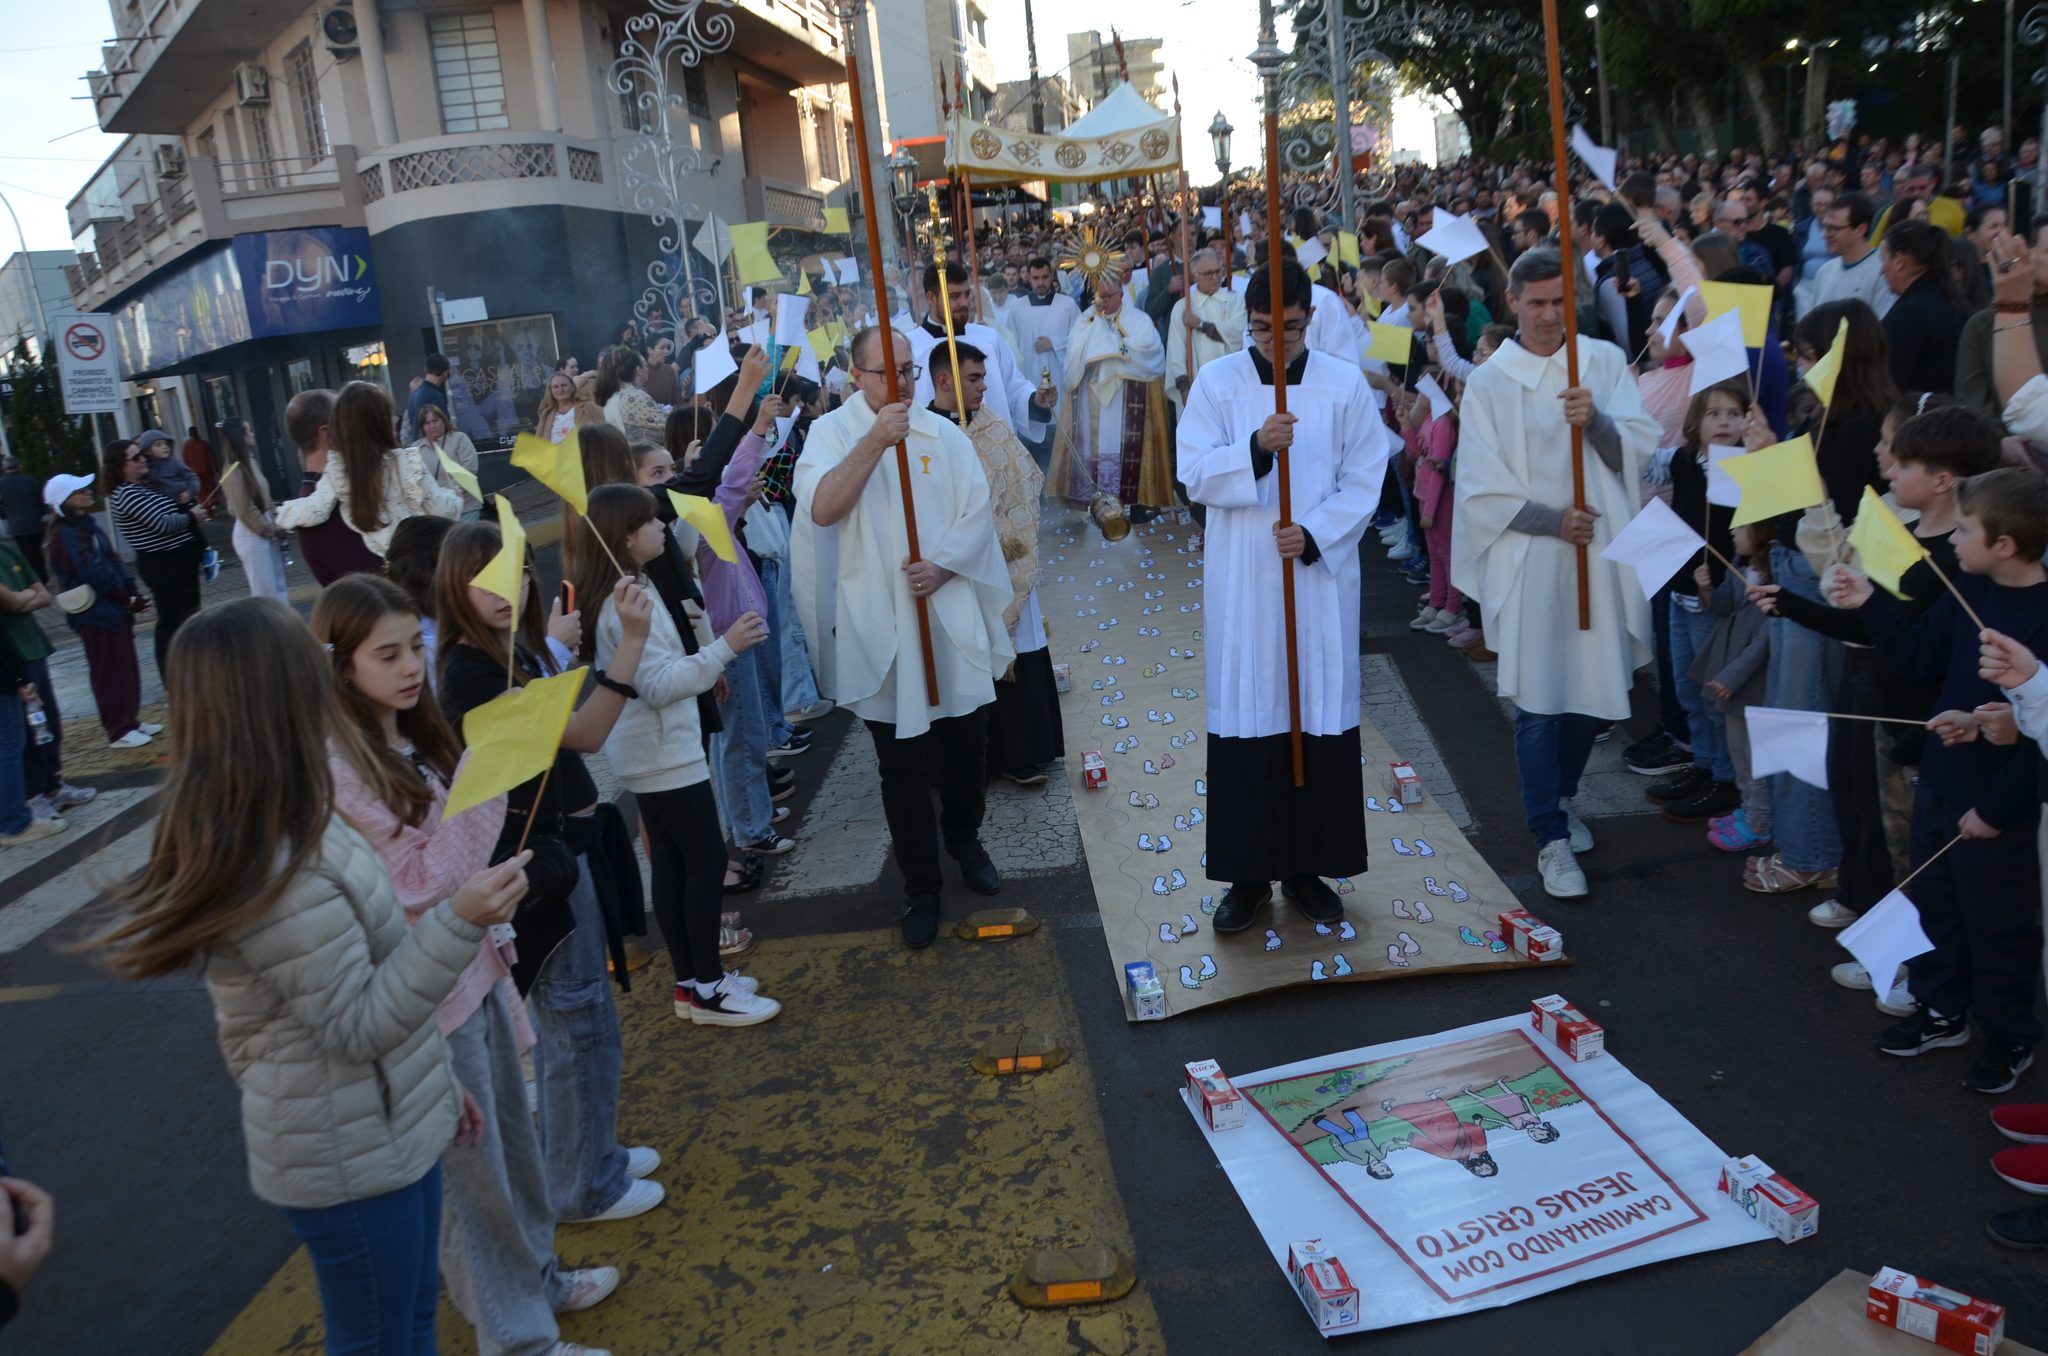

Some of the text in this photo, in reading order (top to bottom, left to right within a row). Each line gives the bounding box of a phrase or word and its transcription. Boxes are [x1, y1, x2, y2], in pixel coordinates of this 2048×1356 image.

[265, 254, 349, 292] DYN
[1416, 1170, 1640, 1259] JESUS CRISTO
[1441, 1194, 1673, 1283] CAMINHANDO COM
